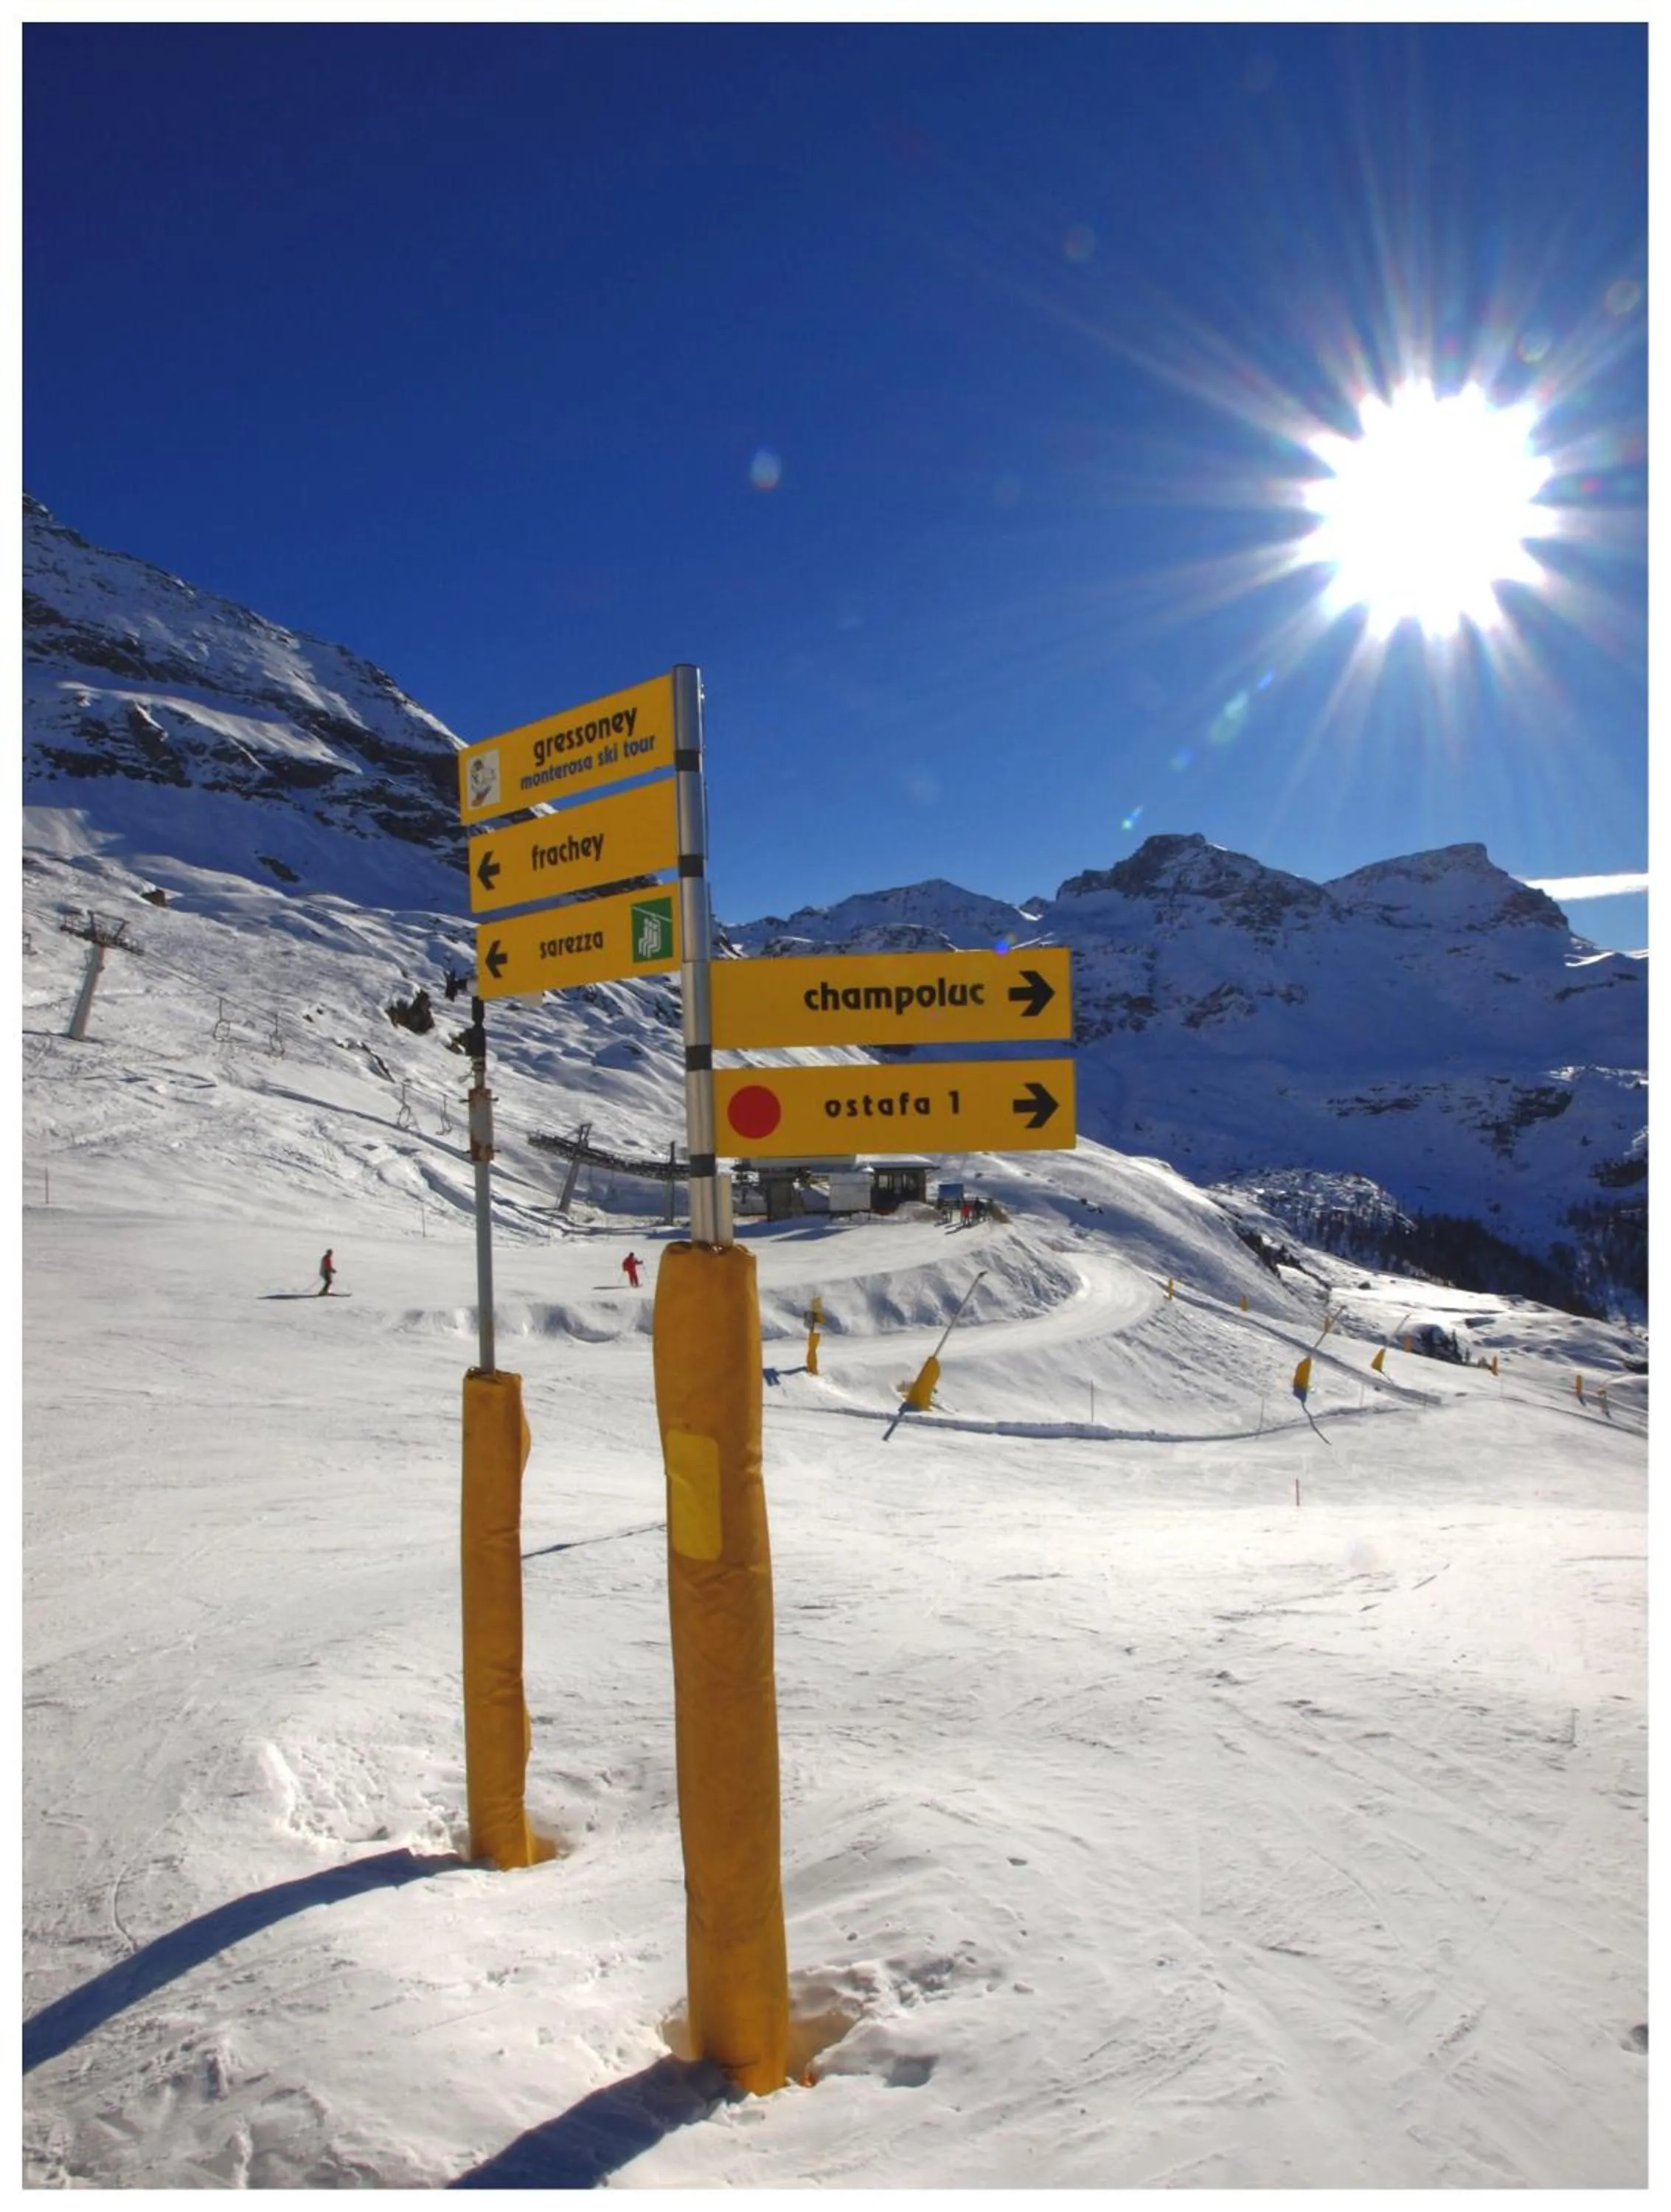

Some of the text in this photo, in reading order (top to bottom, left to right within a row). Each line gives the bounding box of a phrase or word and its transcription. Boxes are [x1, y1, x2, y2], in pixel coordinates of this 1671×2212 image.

[533, 707, 638, 766] gressoney
[521, 734, 655, 790] monterosa ski tour
[532, 833, 604, 871] frachey
[540, 931, 603, 959] sarezza
[804, 978, 984, 1015] champoluc
[824, 1090, 960, 1118] ostafa 1
